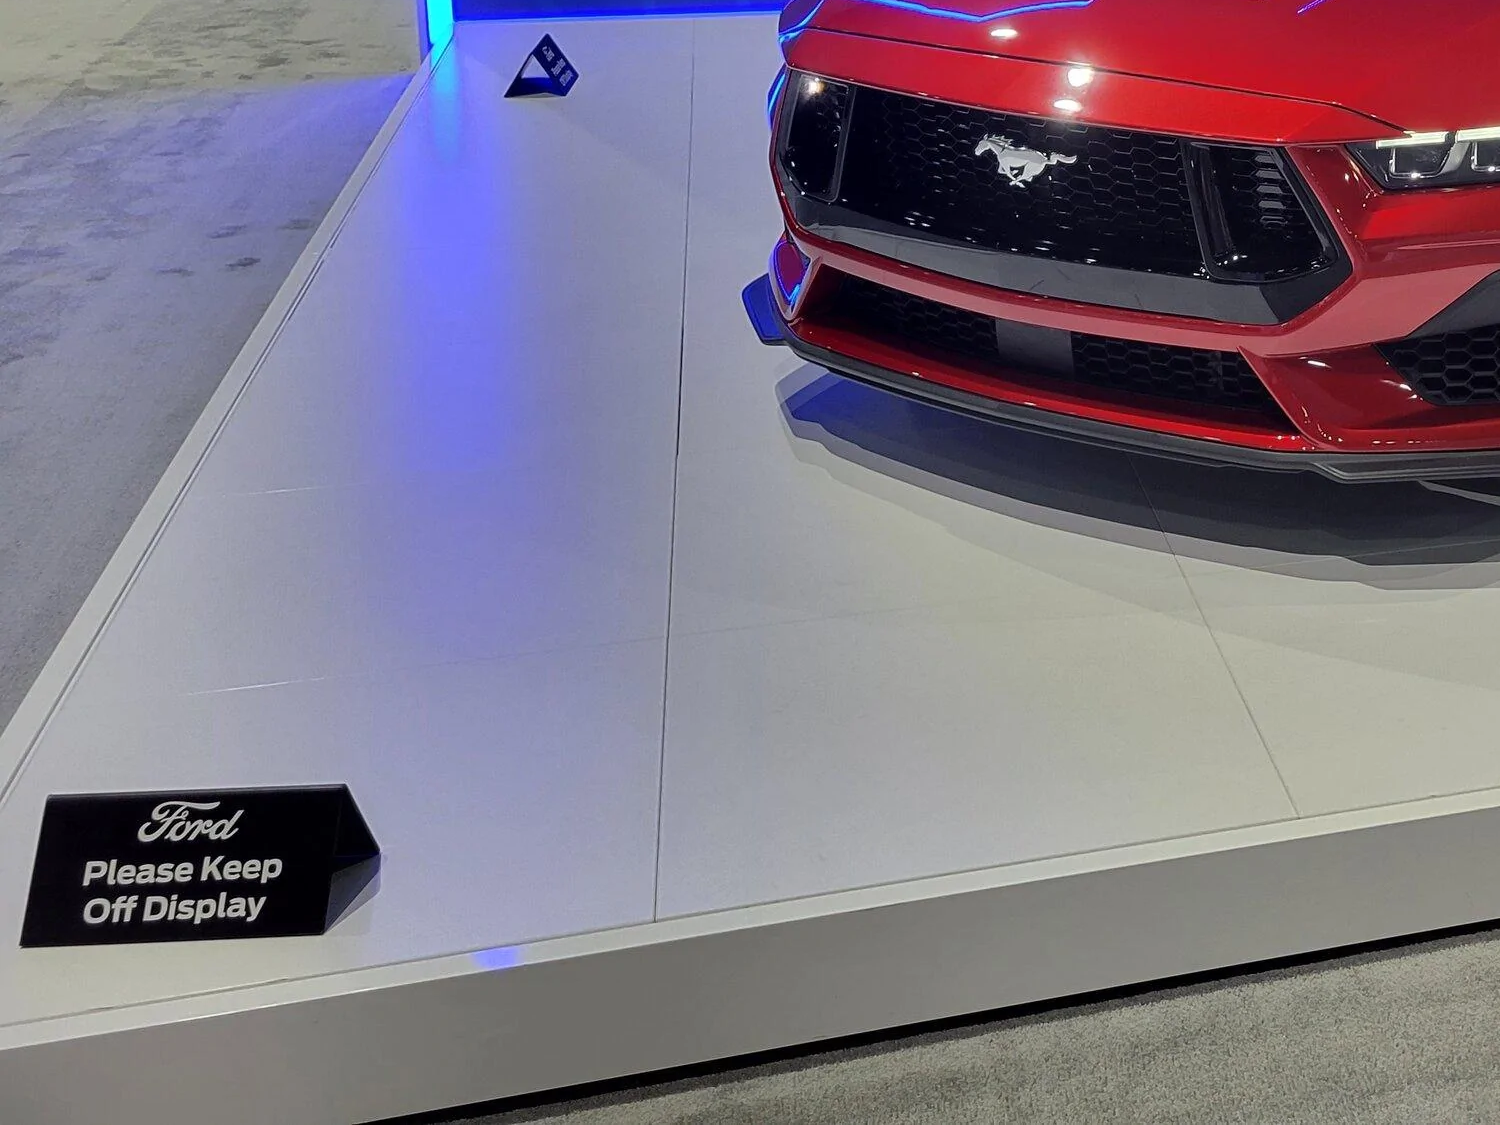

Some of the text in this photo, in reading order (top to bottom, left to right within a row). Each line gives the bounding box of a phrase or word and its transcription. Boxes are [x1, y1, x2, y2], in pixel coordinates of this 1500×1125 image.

[137, 800, 245, 843] Ford
[82, 856, 283, 887] Please Keep
[83, 892, 267, 924] Off Display
